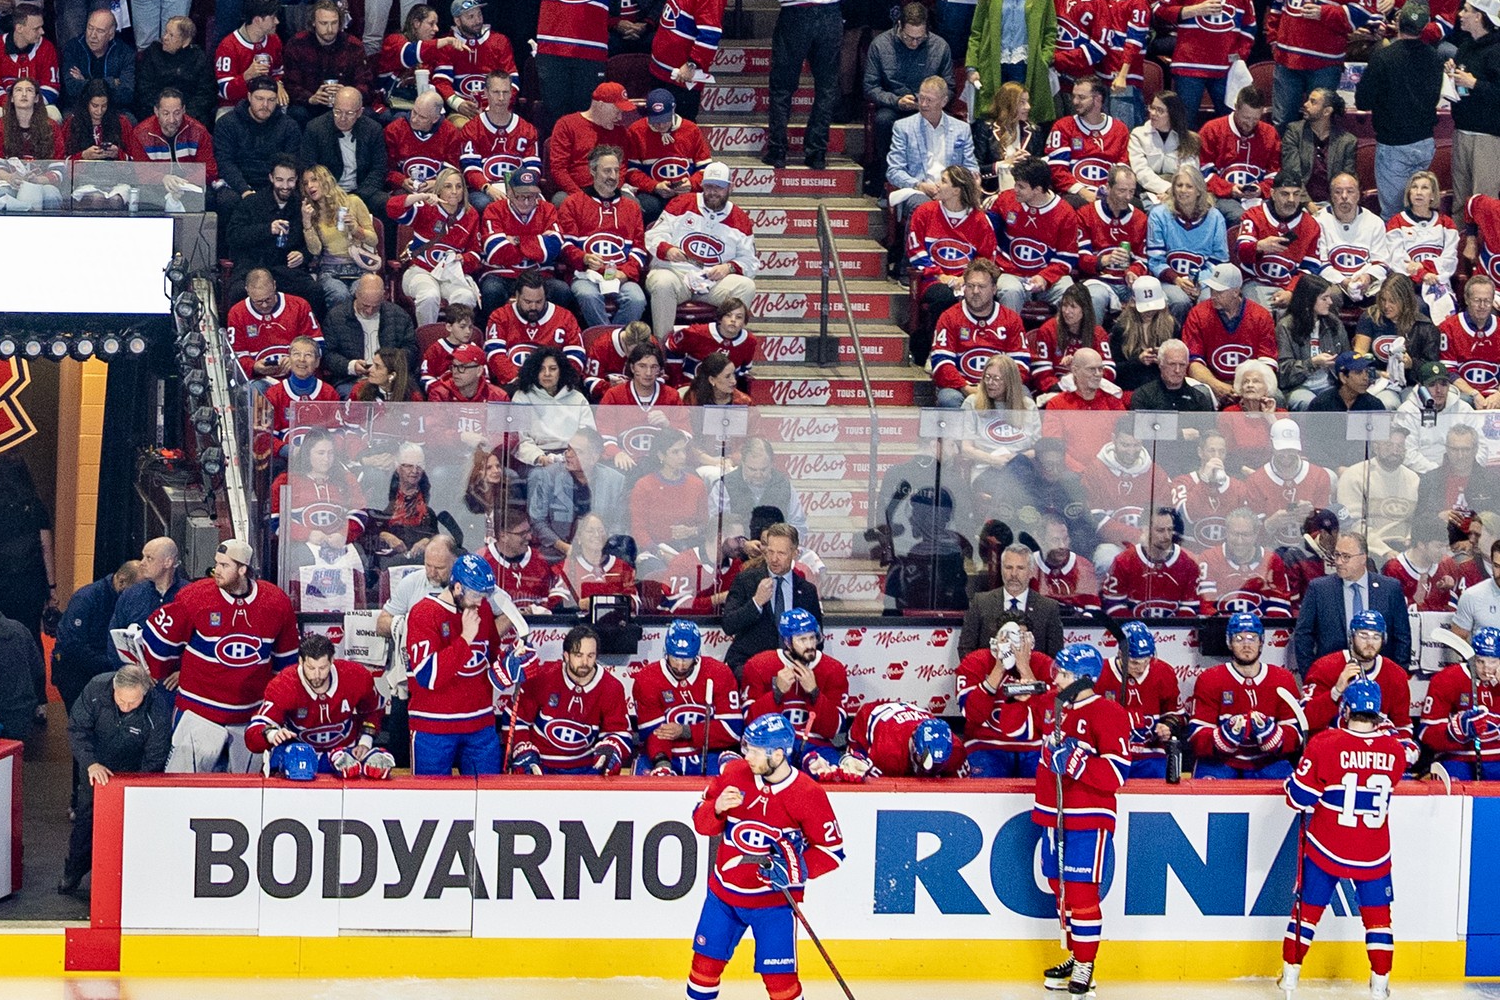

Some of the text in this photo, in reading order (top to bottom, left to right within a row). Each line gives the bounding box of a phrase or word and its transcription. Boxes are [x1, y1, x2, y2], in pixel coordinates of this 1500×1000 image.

[1080, 11, 1093, 26] C
[1132, 8, 1148, 24] 31
[215, 56, 231, 72] 48
[713, 49, 769, 66] lson TOUS
[701, 87, 756, 110] Molson
[516, 137, 528, 151] C
[708, 127, 769, 150] Molson
[782, 178, 799, 186] TOUS
[801, 178, 836, 186] ENSEMBLE
[751, 209, 849, 228] olson TOUS EMBLE
[757, 251, 799, 270] olson
[1143, 289, 1153, 299] 13
[751, 293, 870, 318] Molson TOS ENMBLE
[554, 328, 565, 344] C
[996, 326, 1007, 340] C
[761, 336, 806, 361] Mols
[850, 346, 883, 354] ENEMBLE
[770, 380, 894, 405] Molson TOUS ENEMBLE
[779, 417, 902, 441] Molson TOUS EEMBLE
[784, 455, 847, 479] Molson
[803, 533, 852, 557] Mols
[154, 607, 174, 635] 32
[529, 629, 567, 648] Molso
[701, 630, 735, 648] Mols
[873, 631, 920, 649] Molson
[1062, 633, 1092, 644] olson
[1154, 633, 1177, 643] lson
[846, 664, 876, 677] olson
[915, 664, 956, 682] Molso
[1174, 665, 1204, 684] Mols
[340, 699, 350, 714] A
[1076, 718, 1088, 735] C
[1340, 750, 1396, 771] CAUFIELD
[1337, 770, 1389, 829] 13
[189, 818, 717, 901] BODYARMO
